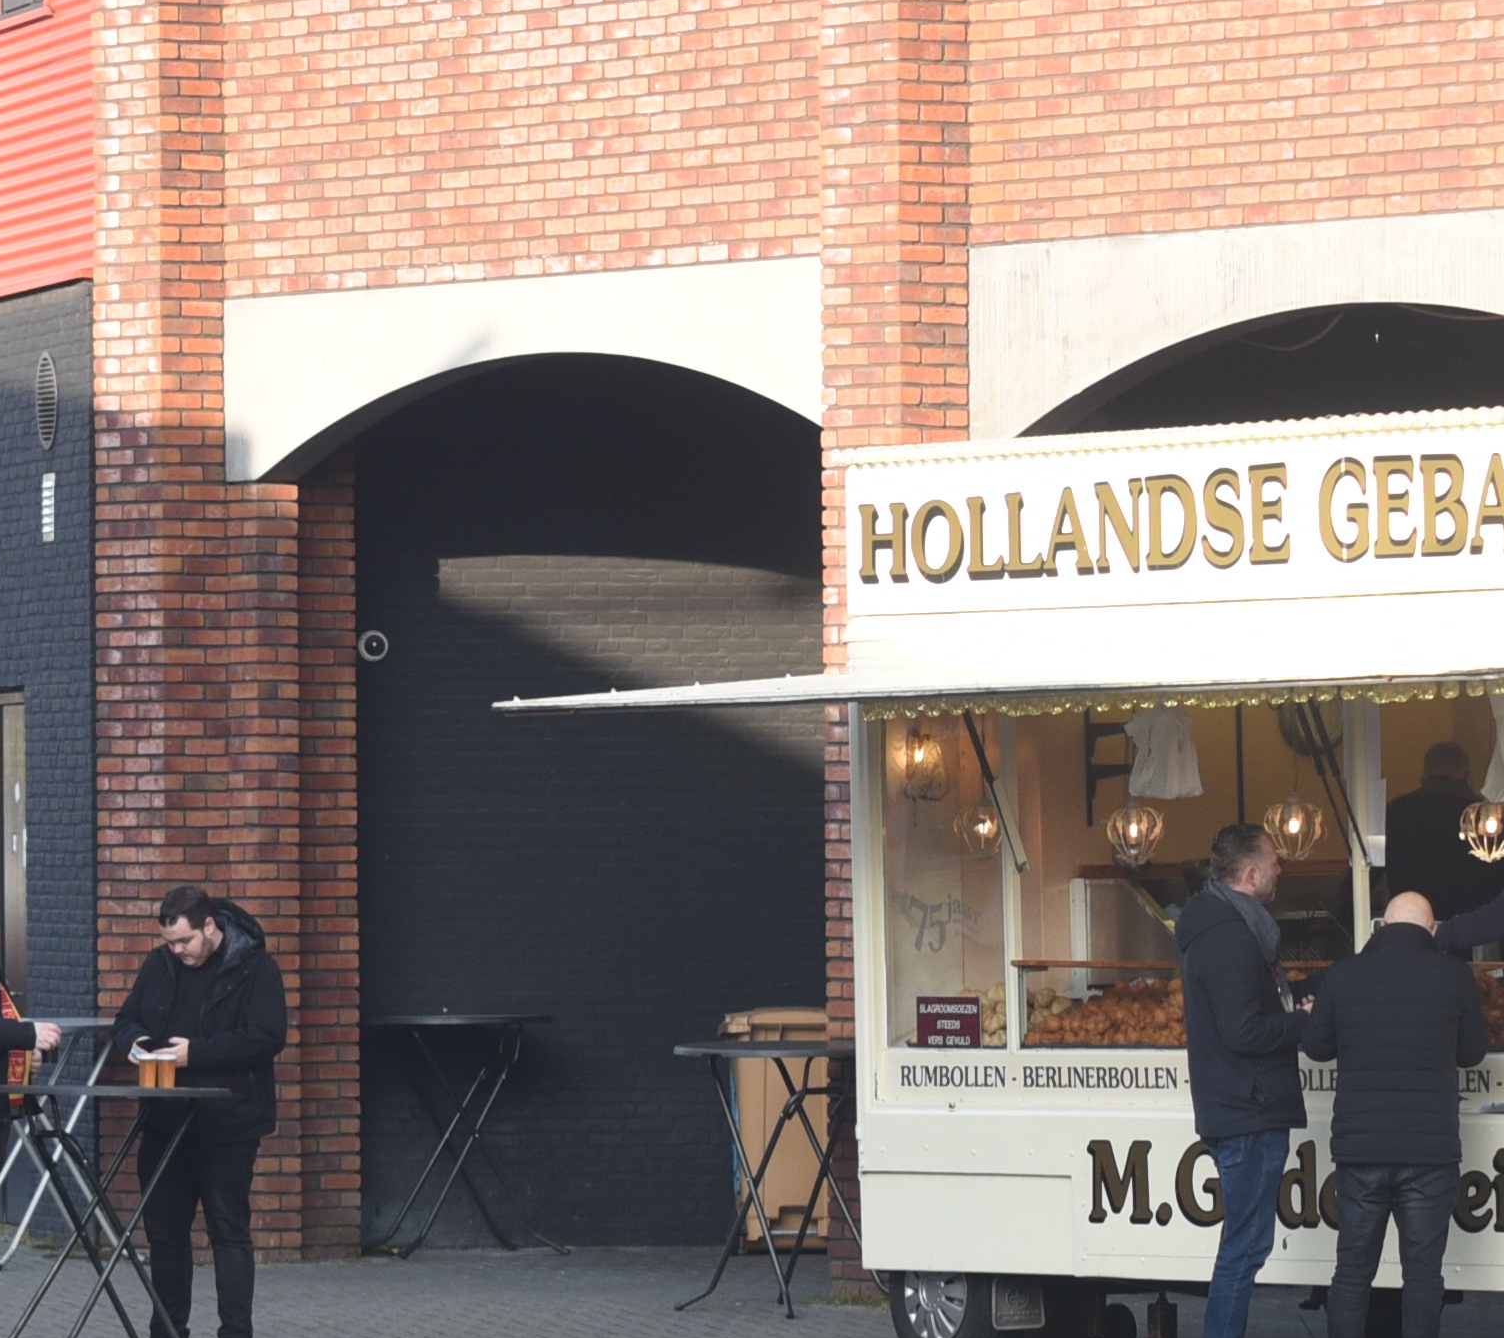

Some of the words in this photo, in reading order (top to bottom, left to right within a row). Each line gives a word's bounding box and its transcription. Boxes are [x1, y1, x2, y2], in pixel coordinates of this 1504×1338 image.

[857, 462, 1292, 584] HOLLANDSE
[909, 895, 947, 953] 75
[927, 1035, 944, 1046] VERS
[945, 1035, 971, 1046] GEVULD
[900, 1065, 1007, 1089] RUMBOLLEN
[1022, 1065, 1179, 1091] BERLINERBOLLEN
